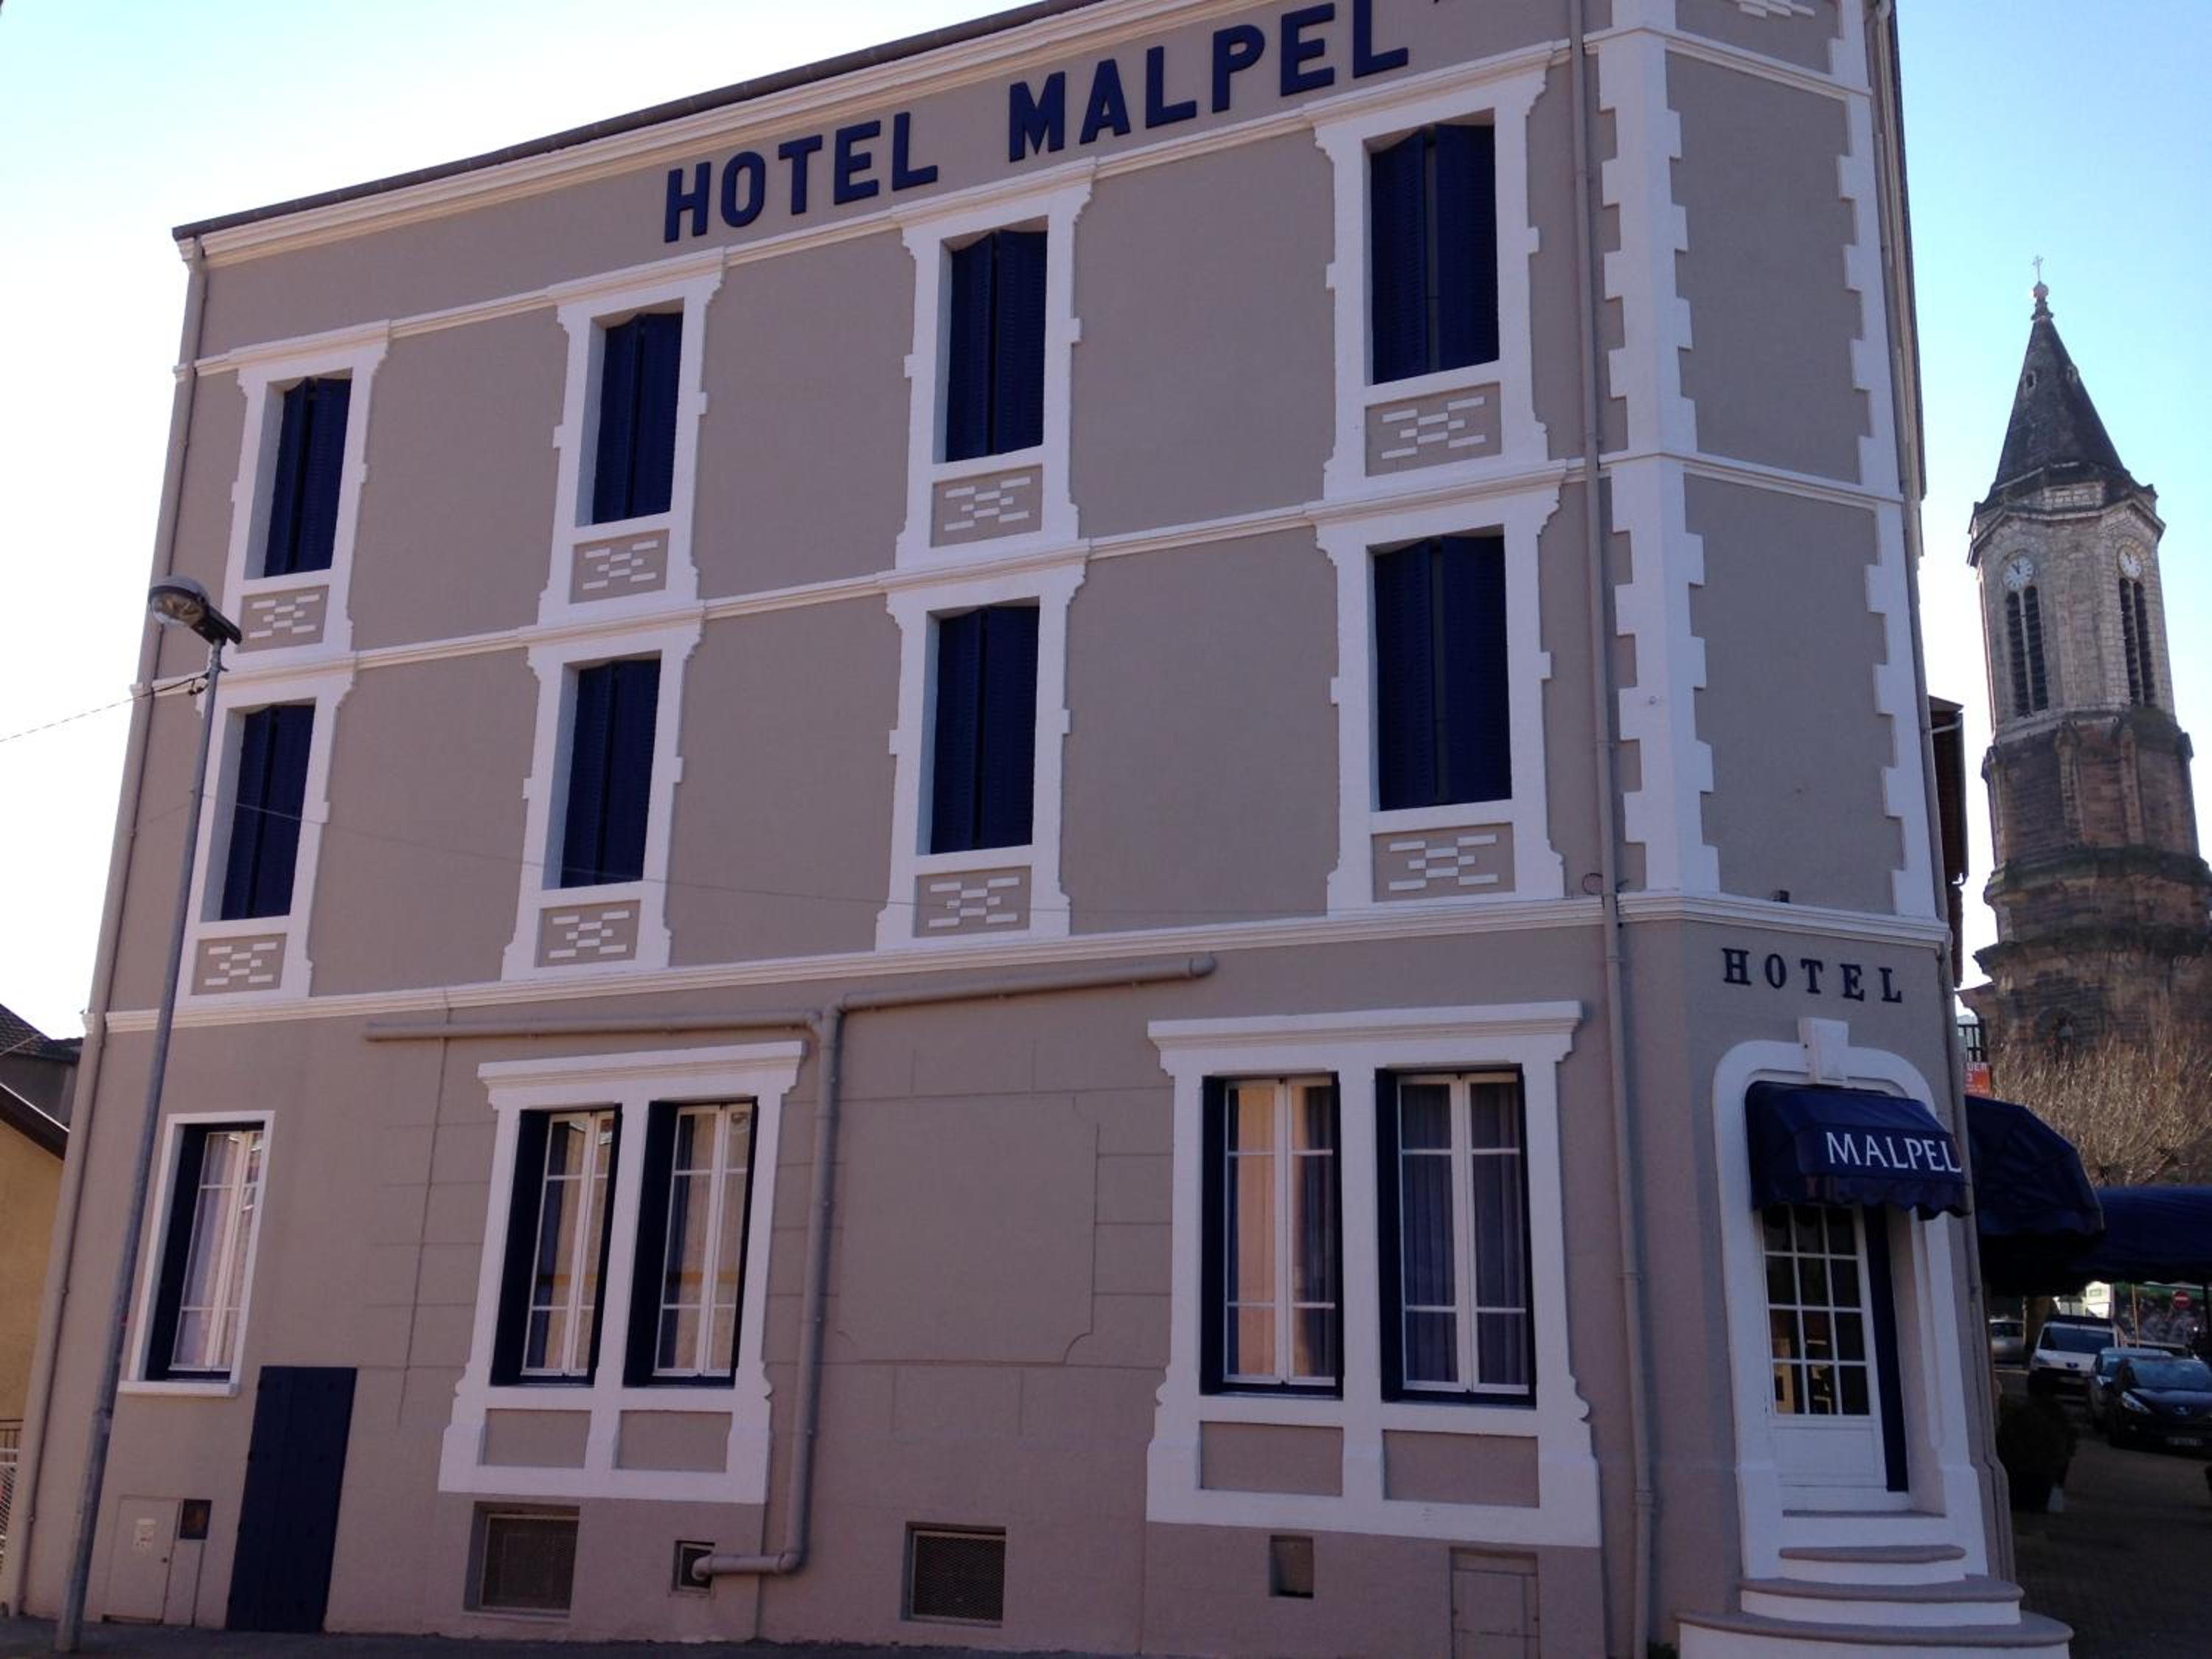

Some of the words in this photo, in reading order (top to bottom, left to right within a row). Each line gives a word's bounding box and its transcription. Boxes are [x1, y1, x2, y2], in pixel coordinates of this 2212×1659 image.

[664, 112, 939, 244] HOTEL
[1009, 0, 1409, 163] MALPEL
[1721, 947, 1902, 1004] HOTEL
[1826, 1131, 1962, 1172] MALPEL
